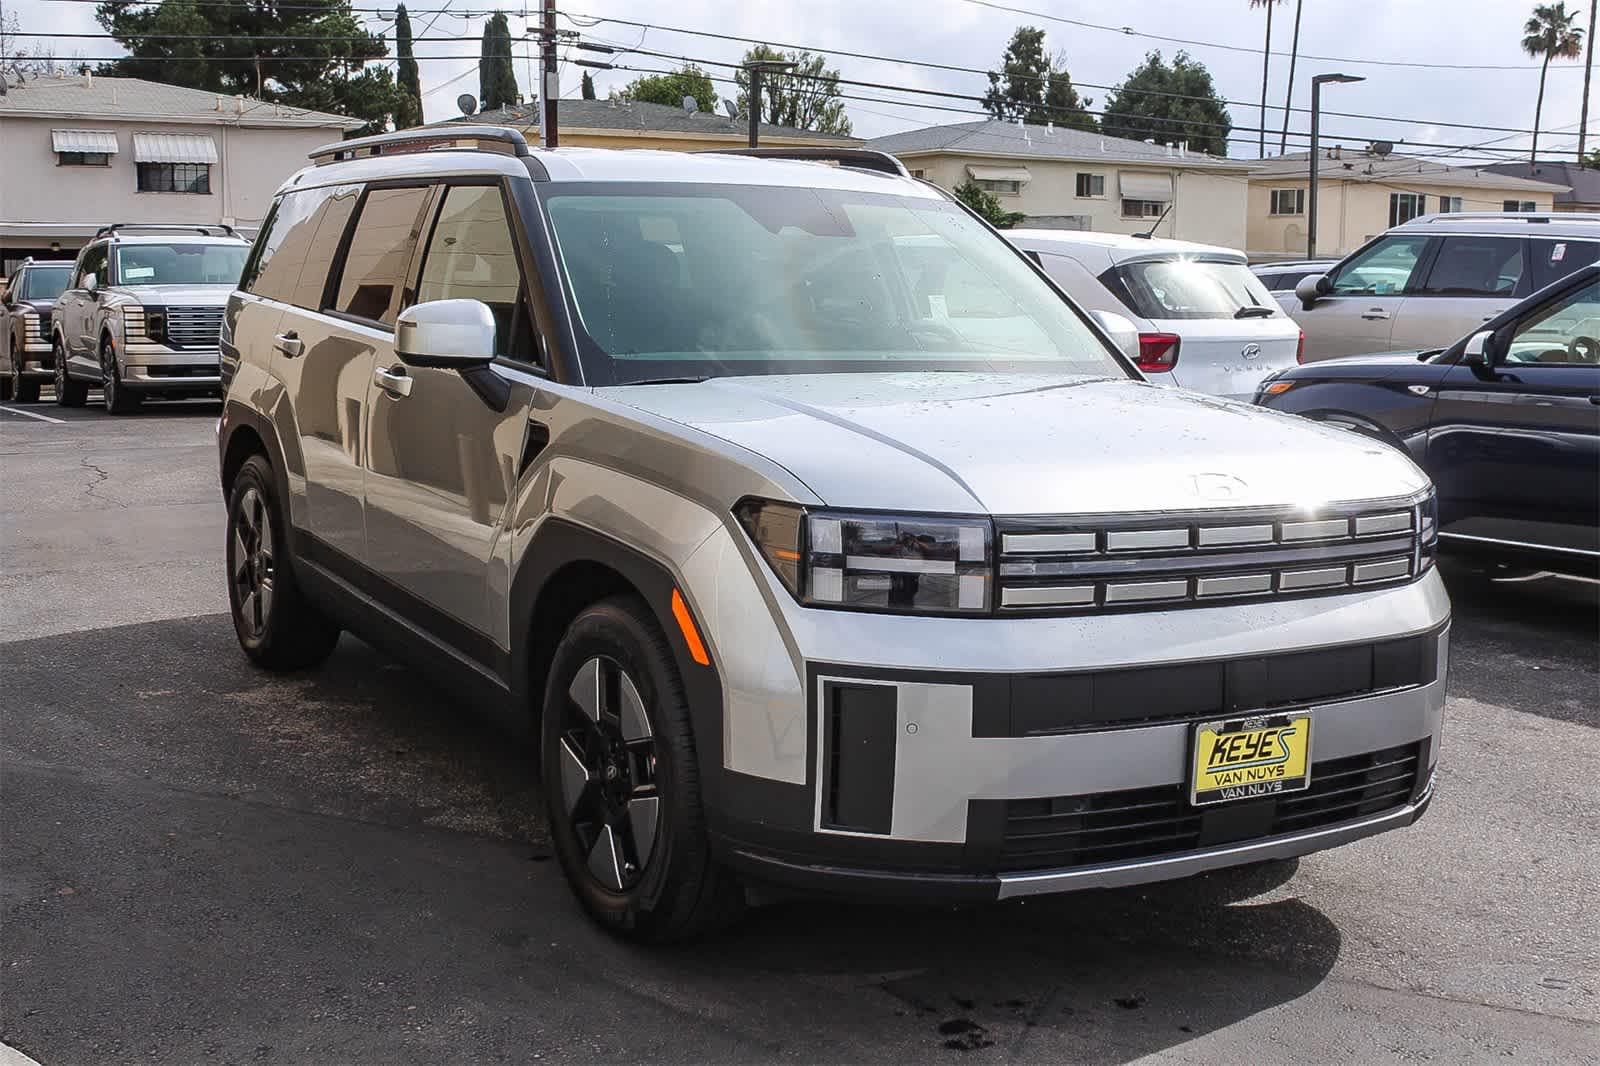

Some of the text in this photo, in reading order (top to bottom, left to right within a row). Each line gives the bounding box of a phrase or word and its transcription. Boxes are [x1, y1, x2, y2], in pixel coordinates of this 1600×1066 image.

[1207, 728, 1296, 770] KEYES
[1214, 765, 1285, 785] VAN NUYS
[1220, 781, 1283, 799] VAN NUYS
